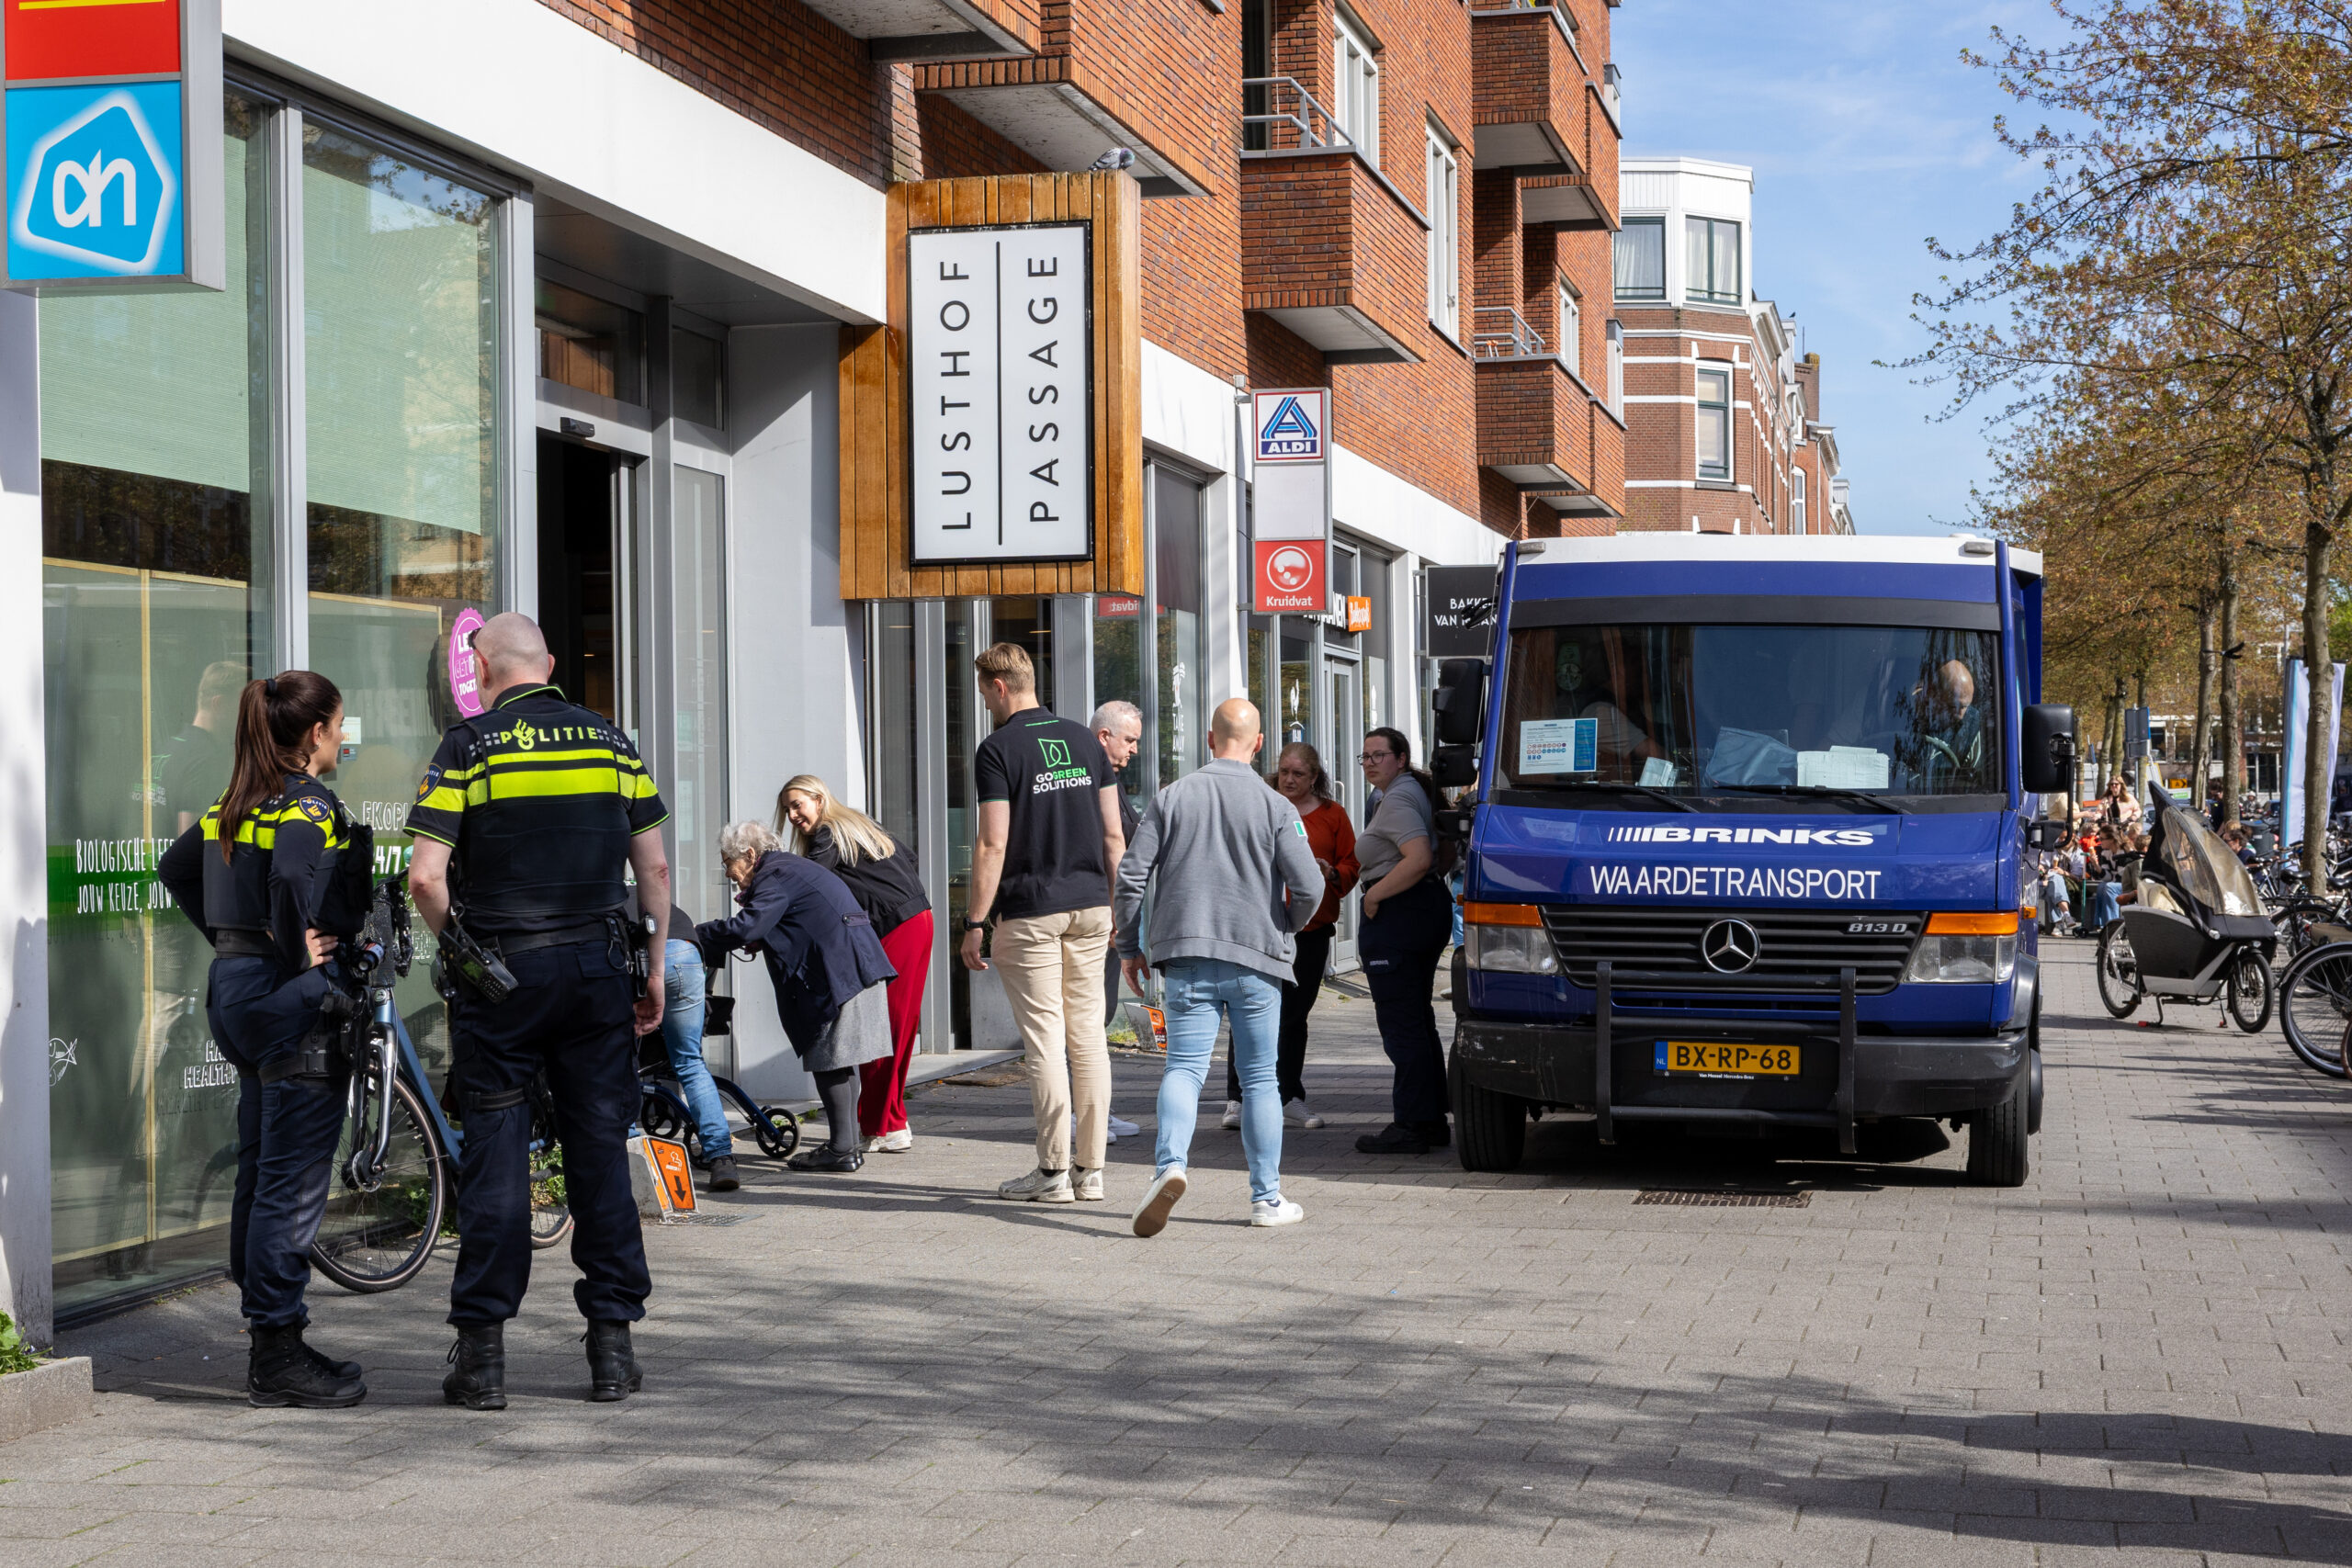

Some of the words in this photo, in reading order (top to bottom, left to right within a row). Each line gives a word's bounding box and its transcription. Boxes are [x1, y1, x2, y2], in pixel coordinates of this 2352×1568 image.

[939, 261, 971, 530] LUSTHOF
[1027, 256, 1059, 523] PASSAGE
[1267, 441, 1311, 454] ALDI
[1266, 595, 1313, 607] Kruidvat
[1450, 598, 1495, 609] BAKKE
[1434, 615, 1457, 626] VAN
[458, 678, 477, 695] TOGET
[1035, 767, 1087, 784] GOGREEN
[1033, 776, 1092, 794] SOLUTIONS
[1651, 828, 1875, 846] BRINKS
[76, 837, 146, 874] BIOLOGISCHE
[371, 845, 401, 874] 4/7
[1589, 865, 1882, 899] WAARDETRANSPORT
[77, 884, 103, 914] JOUW
[108, 882, 142, 913] KEUZE,
[147, 881, 172, 909] JOUW
[1849, 923, 1888, 932] 813
[1893, 923, 1907, 932] D
[1676, 1045, 1792, 1071] BX-RP-68
[184, 1062, 237, 1089] HEALTHY
